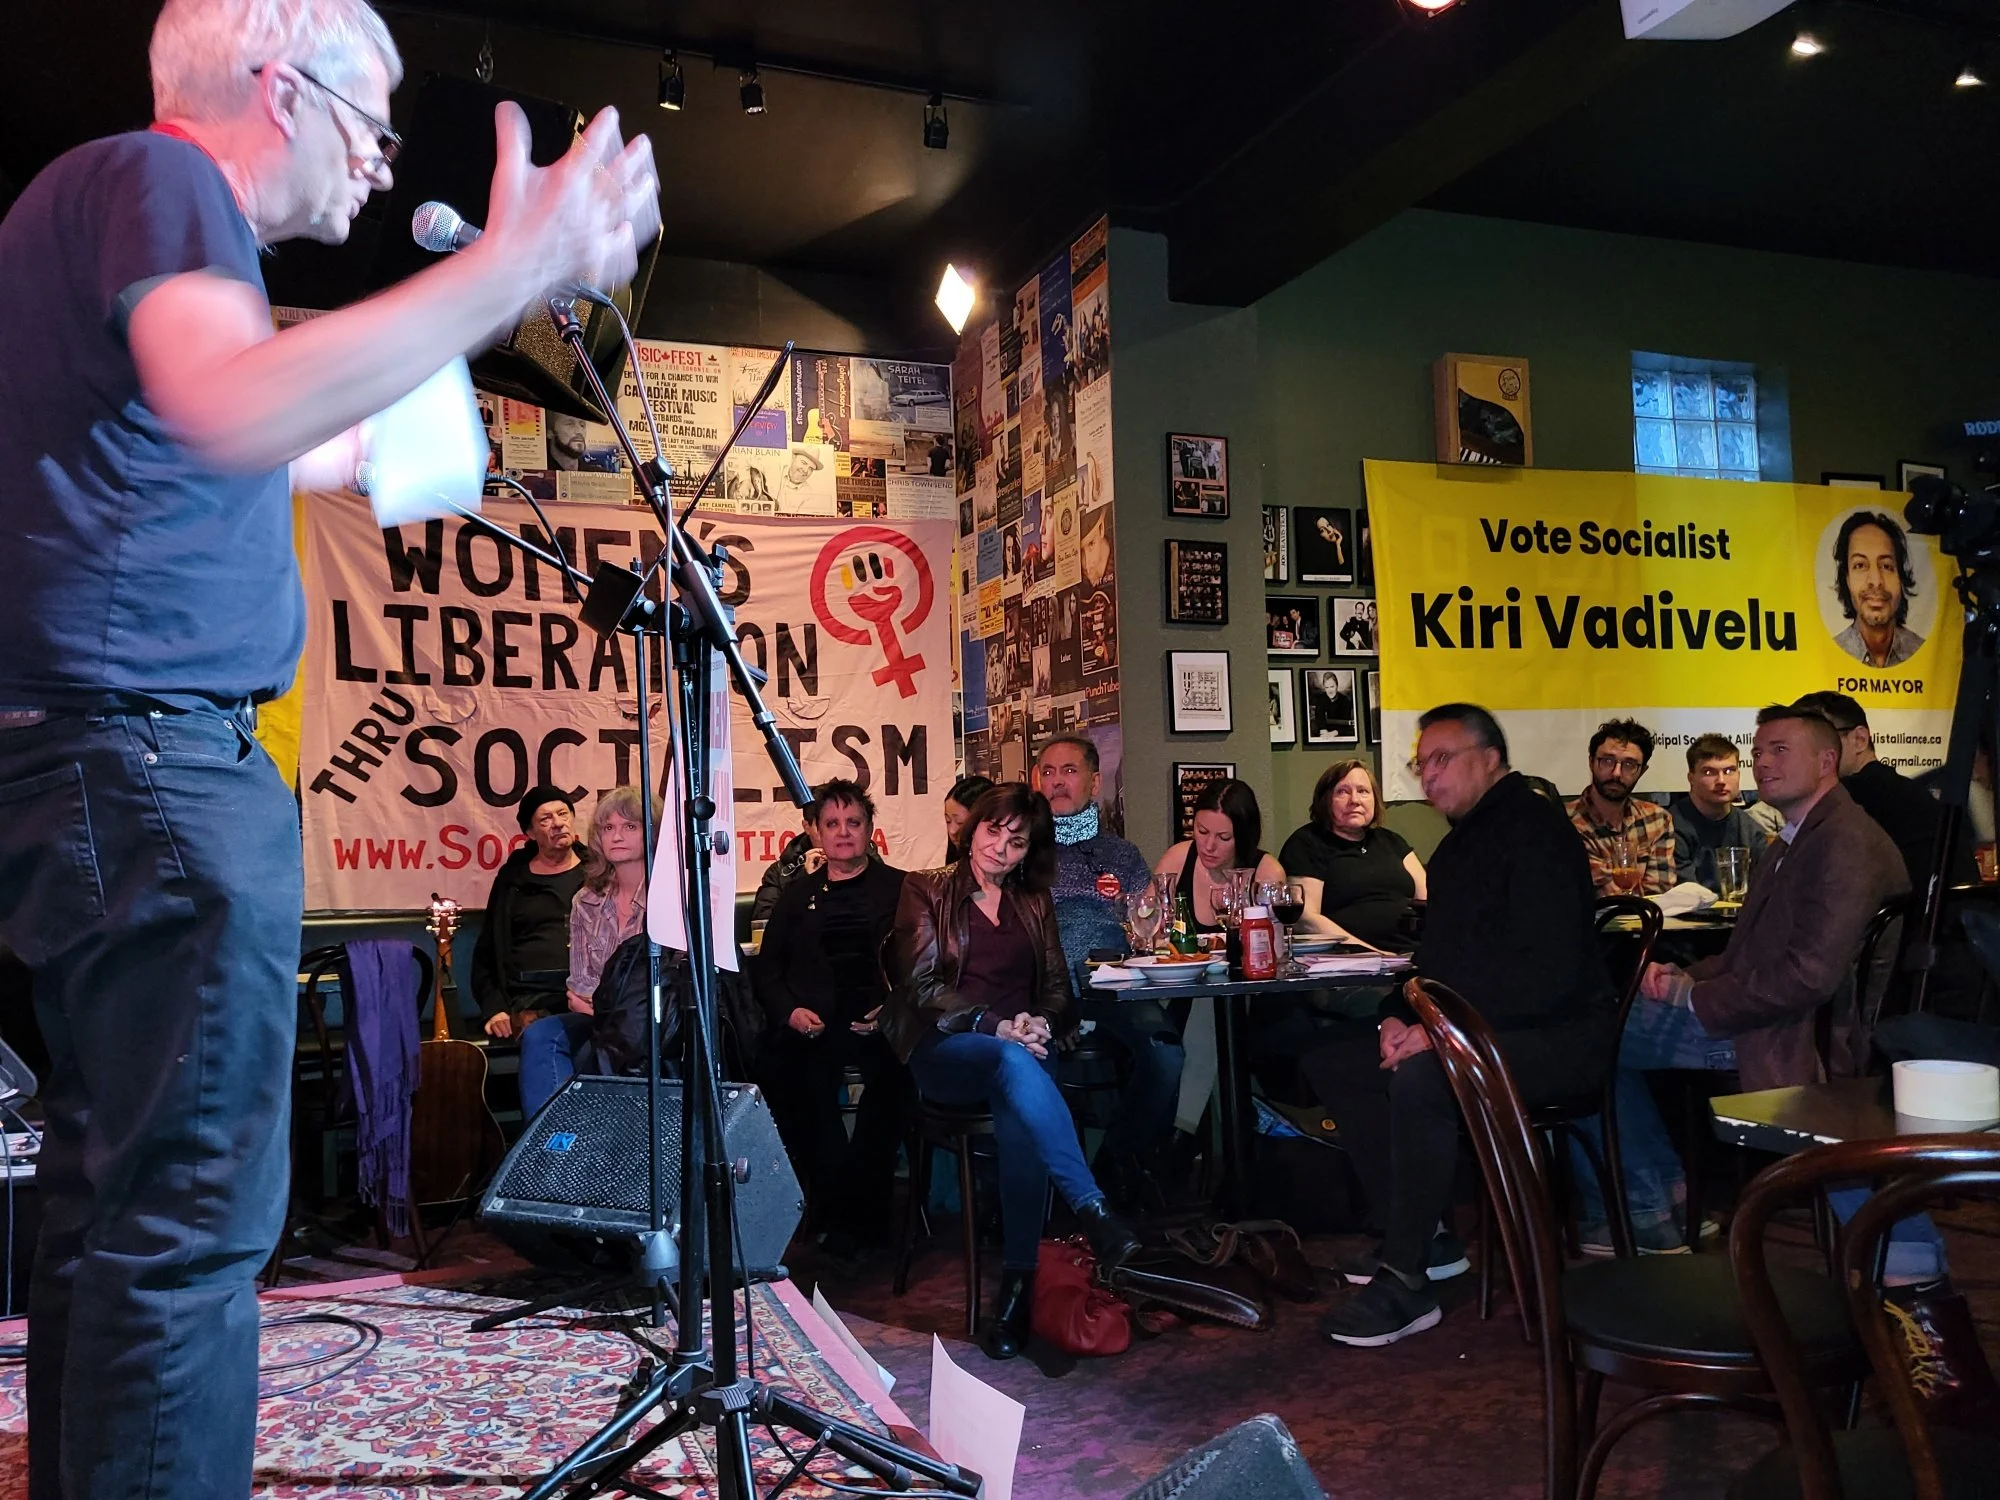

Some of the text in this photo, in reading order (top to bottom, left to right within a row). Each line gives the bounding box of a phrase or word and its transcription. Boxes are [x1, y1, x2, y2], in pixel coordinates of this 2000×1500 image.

[670, 350, 702, 366] FEST
[887, 364, 921, 375] SARAH
[668, 373, 693, 382] CHANCE
[706, 375, 719, 384] WIN
[897, 375, 928, 385] TEITEL
[682, 389, 718, 403] MUSIC
[640, 412, 682, 422] WSTBANDS
[629, 420, 718, 439] MOLON CANADIAN
[755, 447, 781, 457] BLAIN
[911, 480, 953, 489] TOWNSEND
[1480, 518, 1731, 560] Vote Socialist
[1411, 585, 1798, 651] Kiri Vadivelu
[333, 600, 818, 698] LIBERAON
[1838, 678, 1924, 693] FOR MAYOR
[1872, 732, 1942, 744] listalliance.ca
[309, 687, 415, 804] THRU
[1880, 756, 1942, 768] @gmail.com
